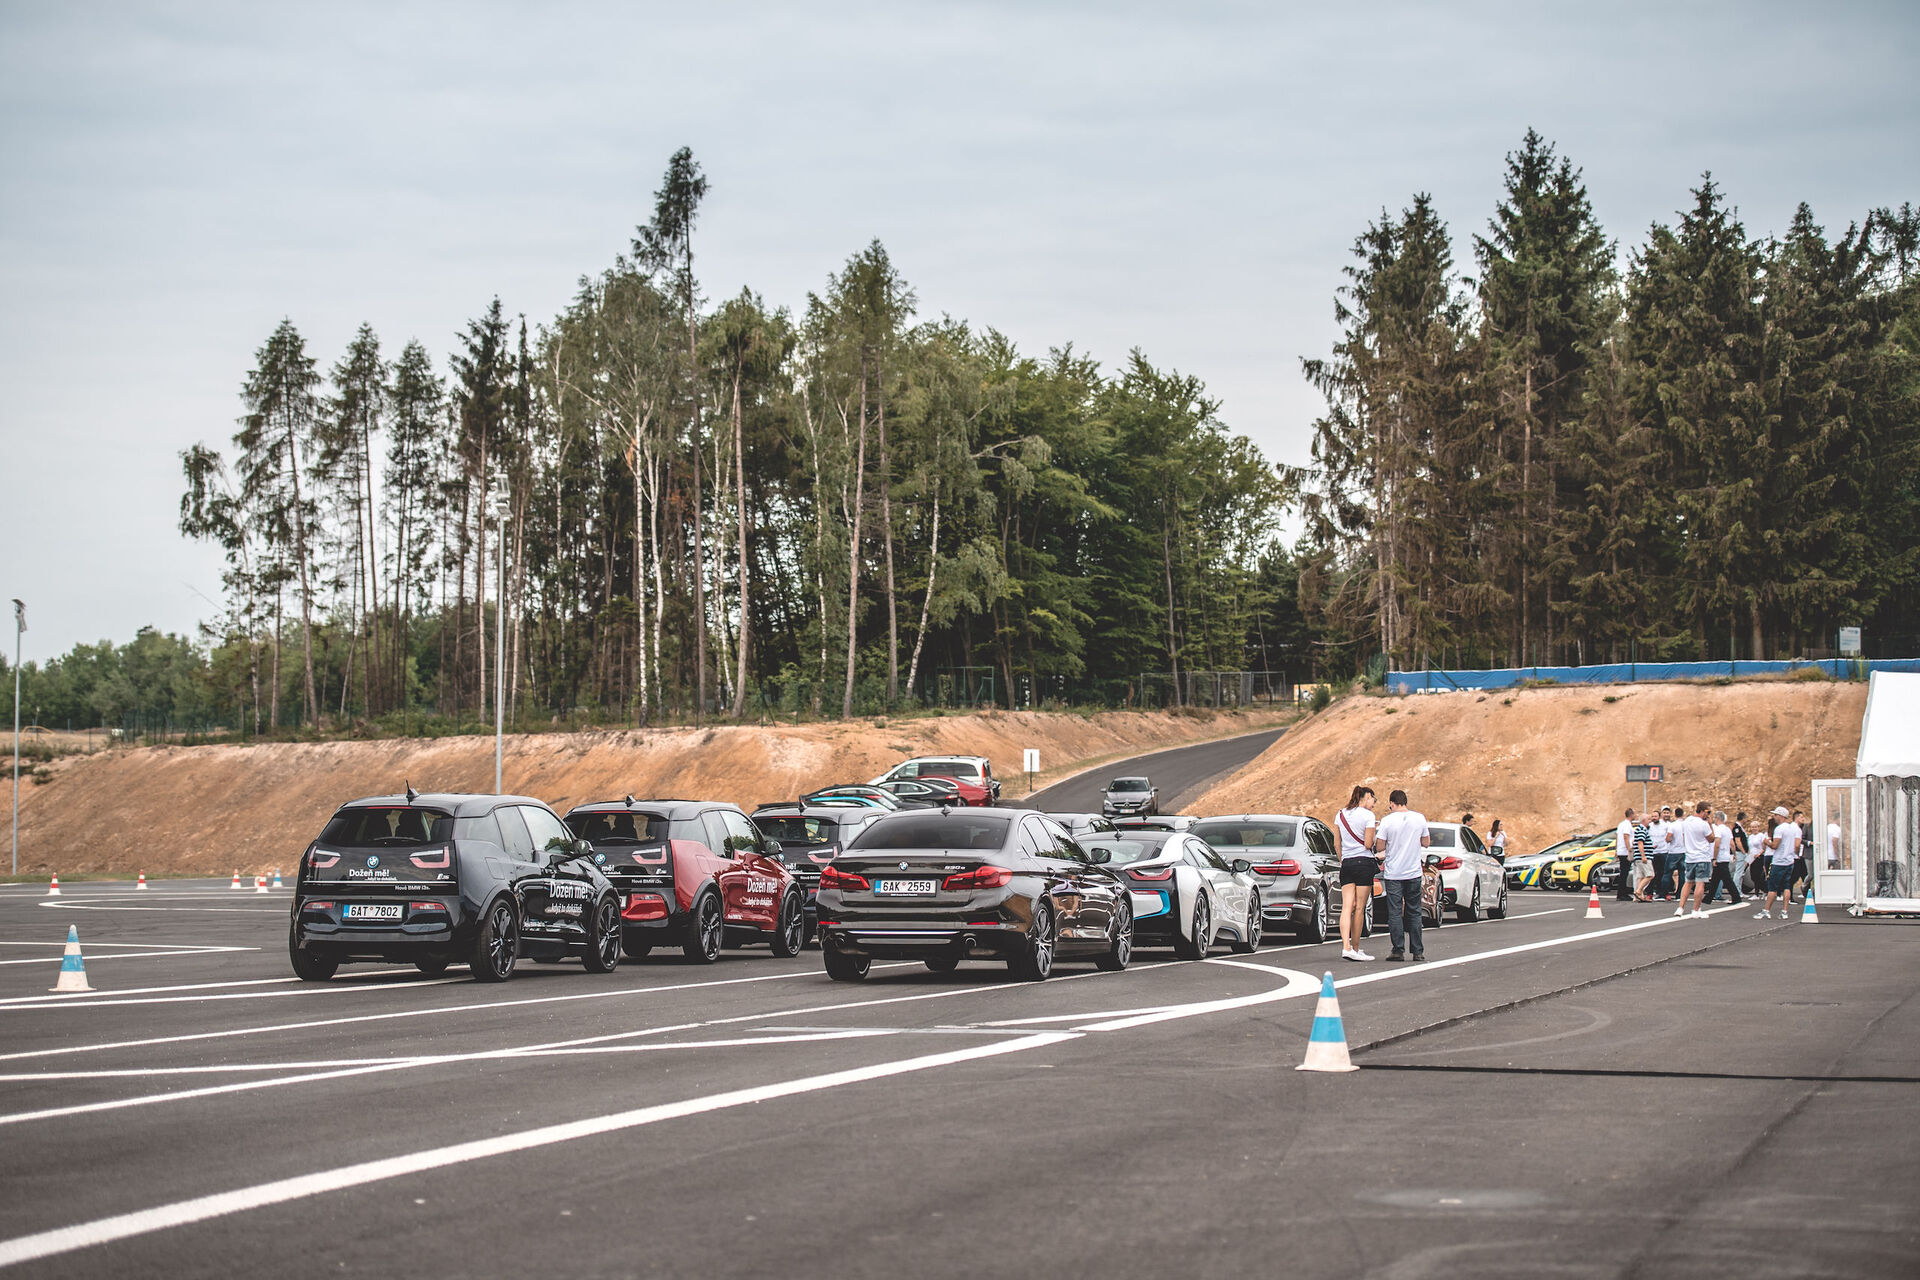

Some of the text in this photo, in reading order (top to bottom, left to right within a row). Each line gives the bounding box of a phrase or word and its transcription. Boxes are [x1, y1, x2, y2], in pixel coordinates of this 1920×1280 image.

[882, 882, 930, 892] 6AK 2559
[351, 907, 398, 916] 6AT 7802
